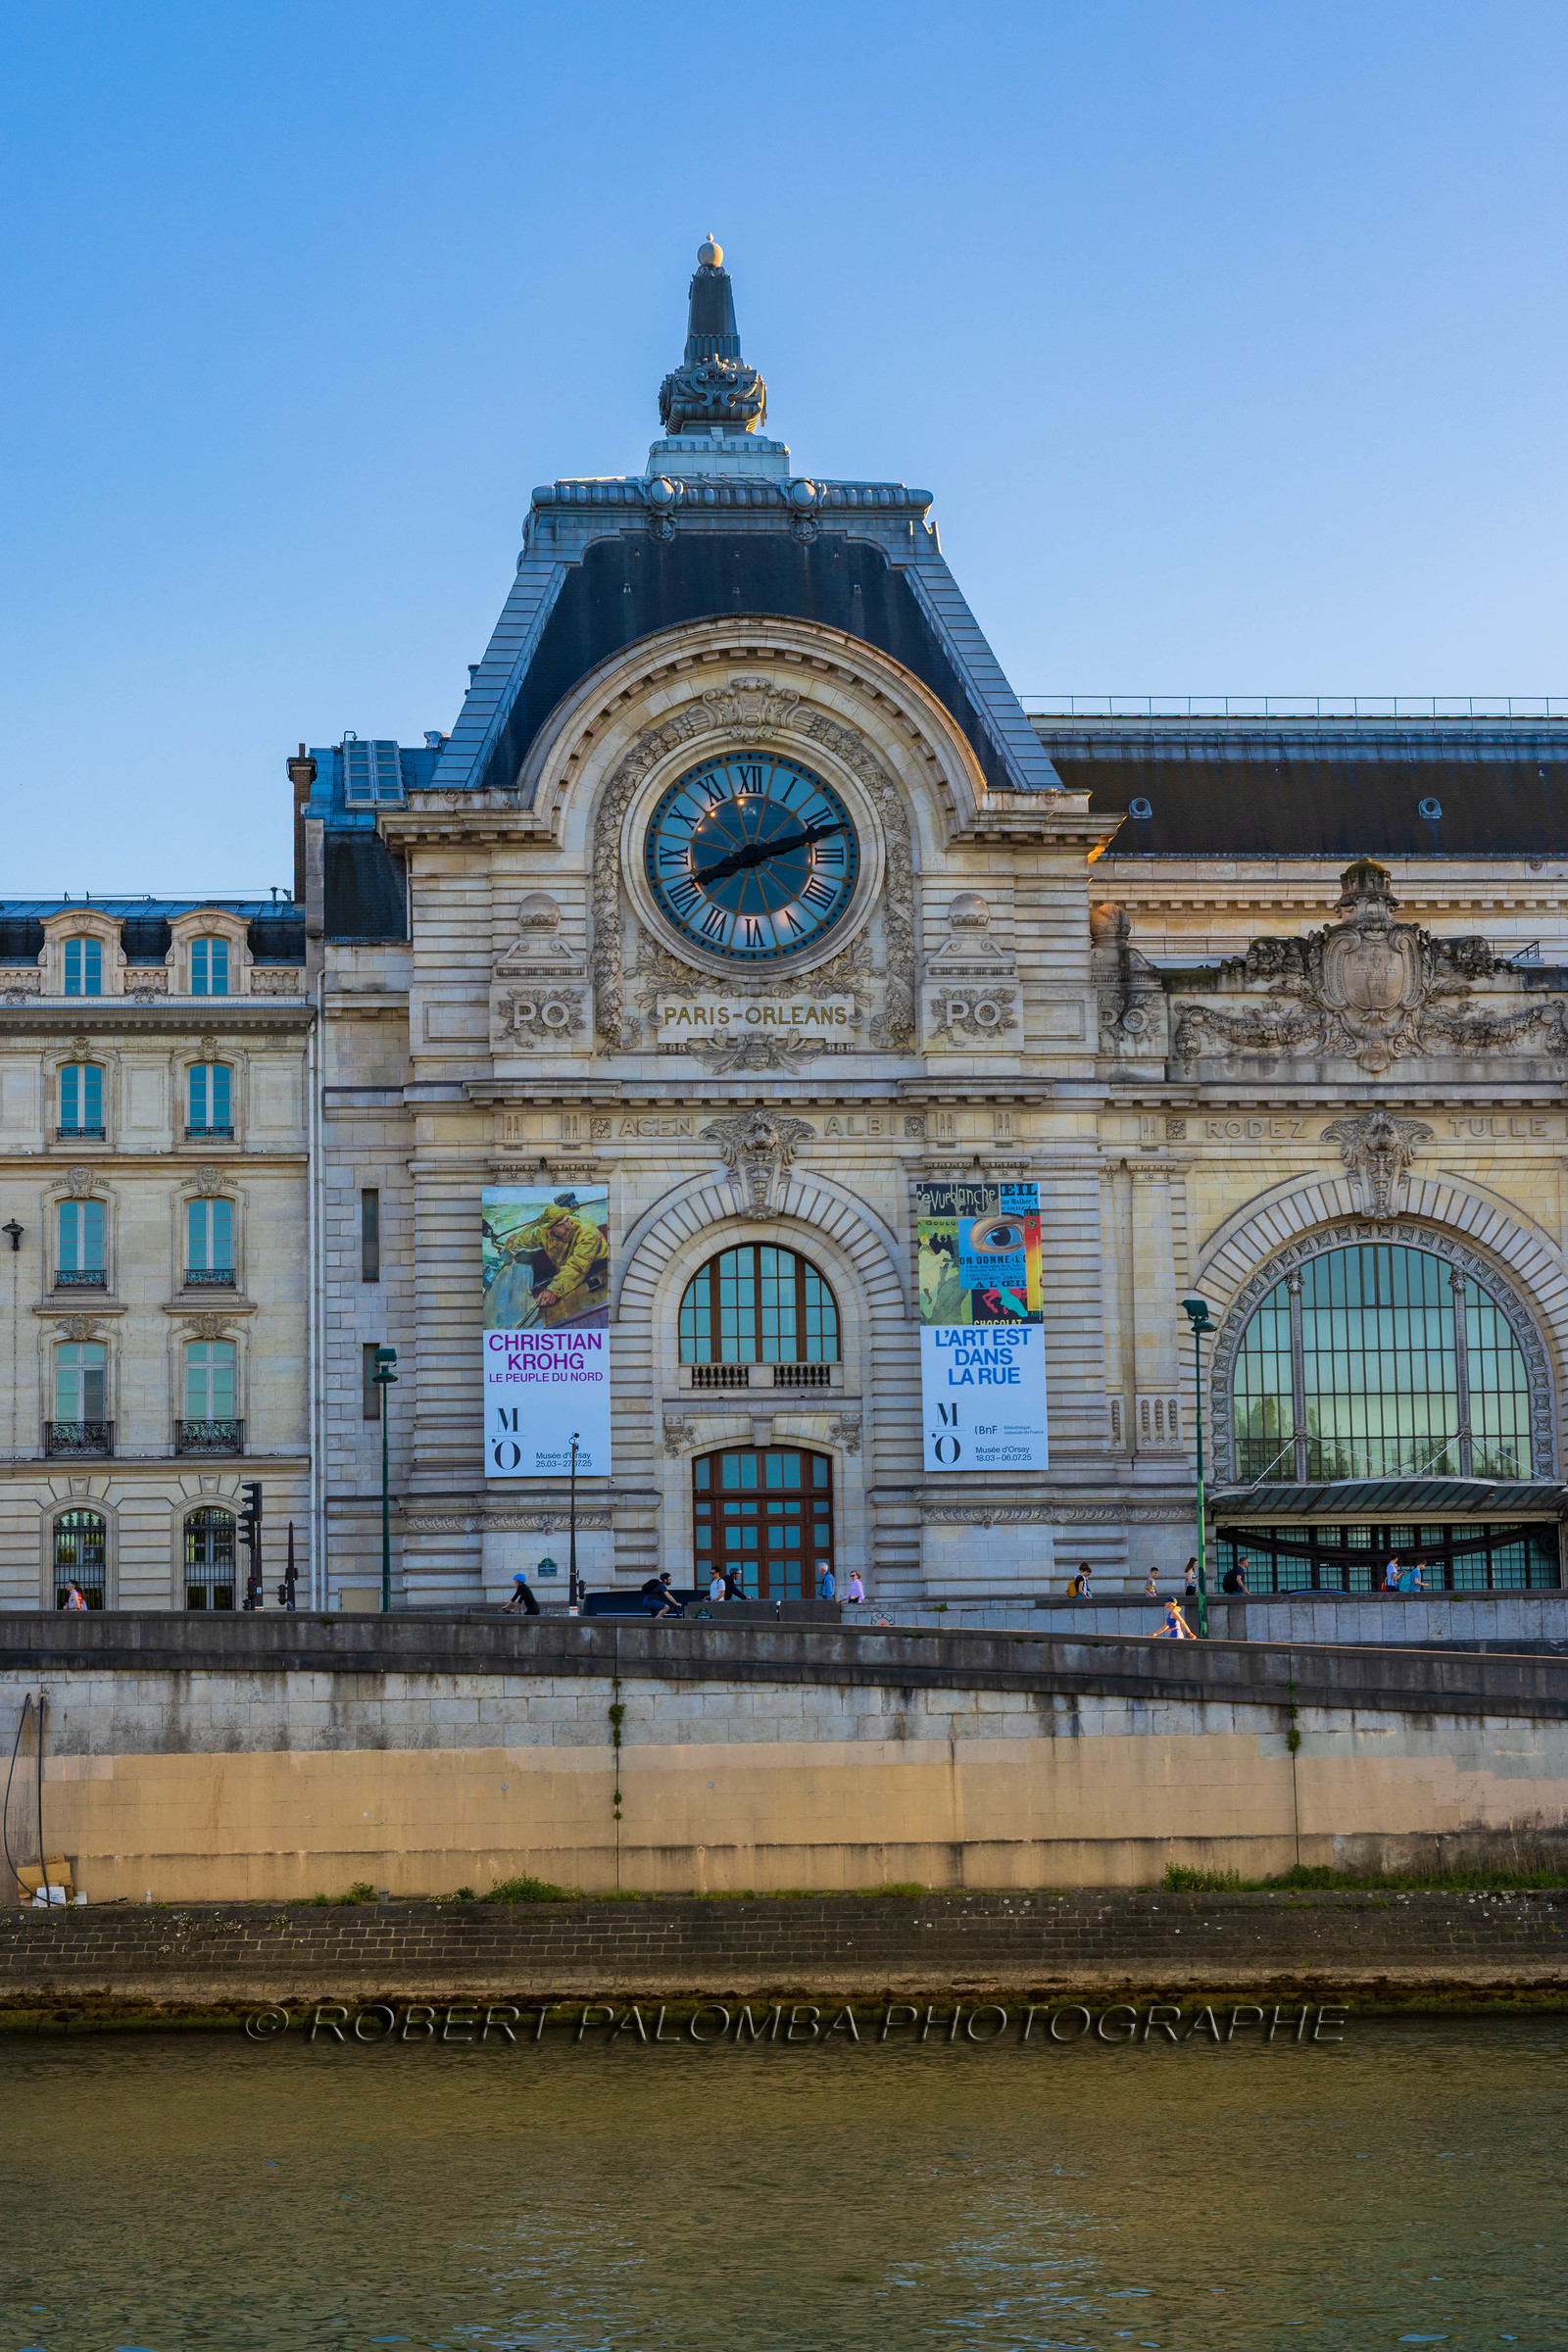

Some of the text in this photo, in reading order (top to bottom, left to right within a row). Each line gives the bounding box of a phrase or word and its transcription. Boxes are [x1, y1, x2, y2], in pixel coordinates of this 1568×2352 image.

[737, 765, 763, 795] XII
[667, 805, 700, 831] X
[814, 847, 844, 865] III
[514, 1000, 569, 1029] PO
[664, 1006, 848, 1025] PARIS-ORLEANS
[947, 1000, 1001, 1027] PO
[618, 1117, 694, 1137] AGEN
[824, 1116, 897, 1136] ALBI
[1206, 1118, 1307, 1139] RODEZ
[1448, 1117, 1548, 1138] TULLE
[489, 1333, 602, 1351] CHRISTIAN
[935, 1328, 1032, 1347] L'ART EST
[508, 1352, 584, 1370] KROHG
[955, 1348, 1013, 1366] DANS
[489, 1372, 603, 1383] LE PEUPLE DU NORD
[949, 1367, 1021, 1386] LA RUE
